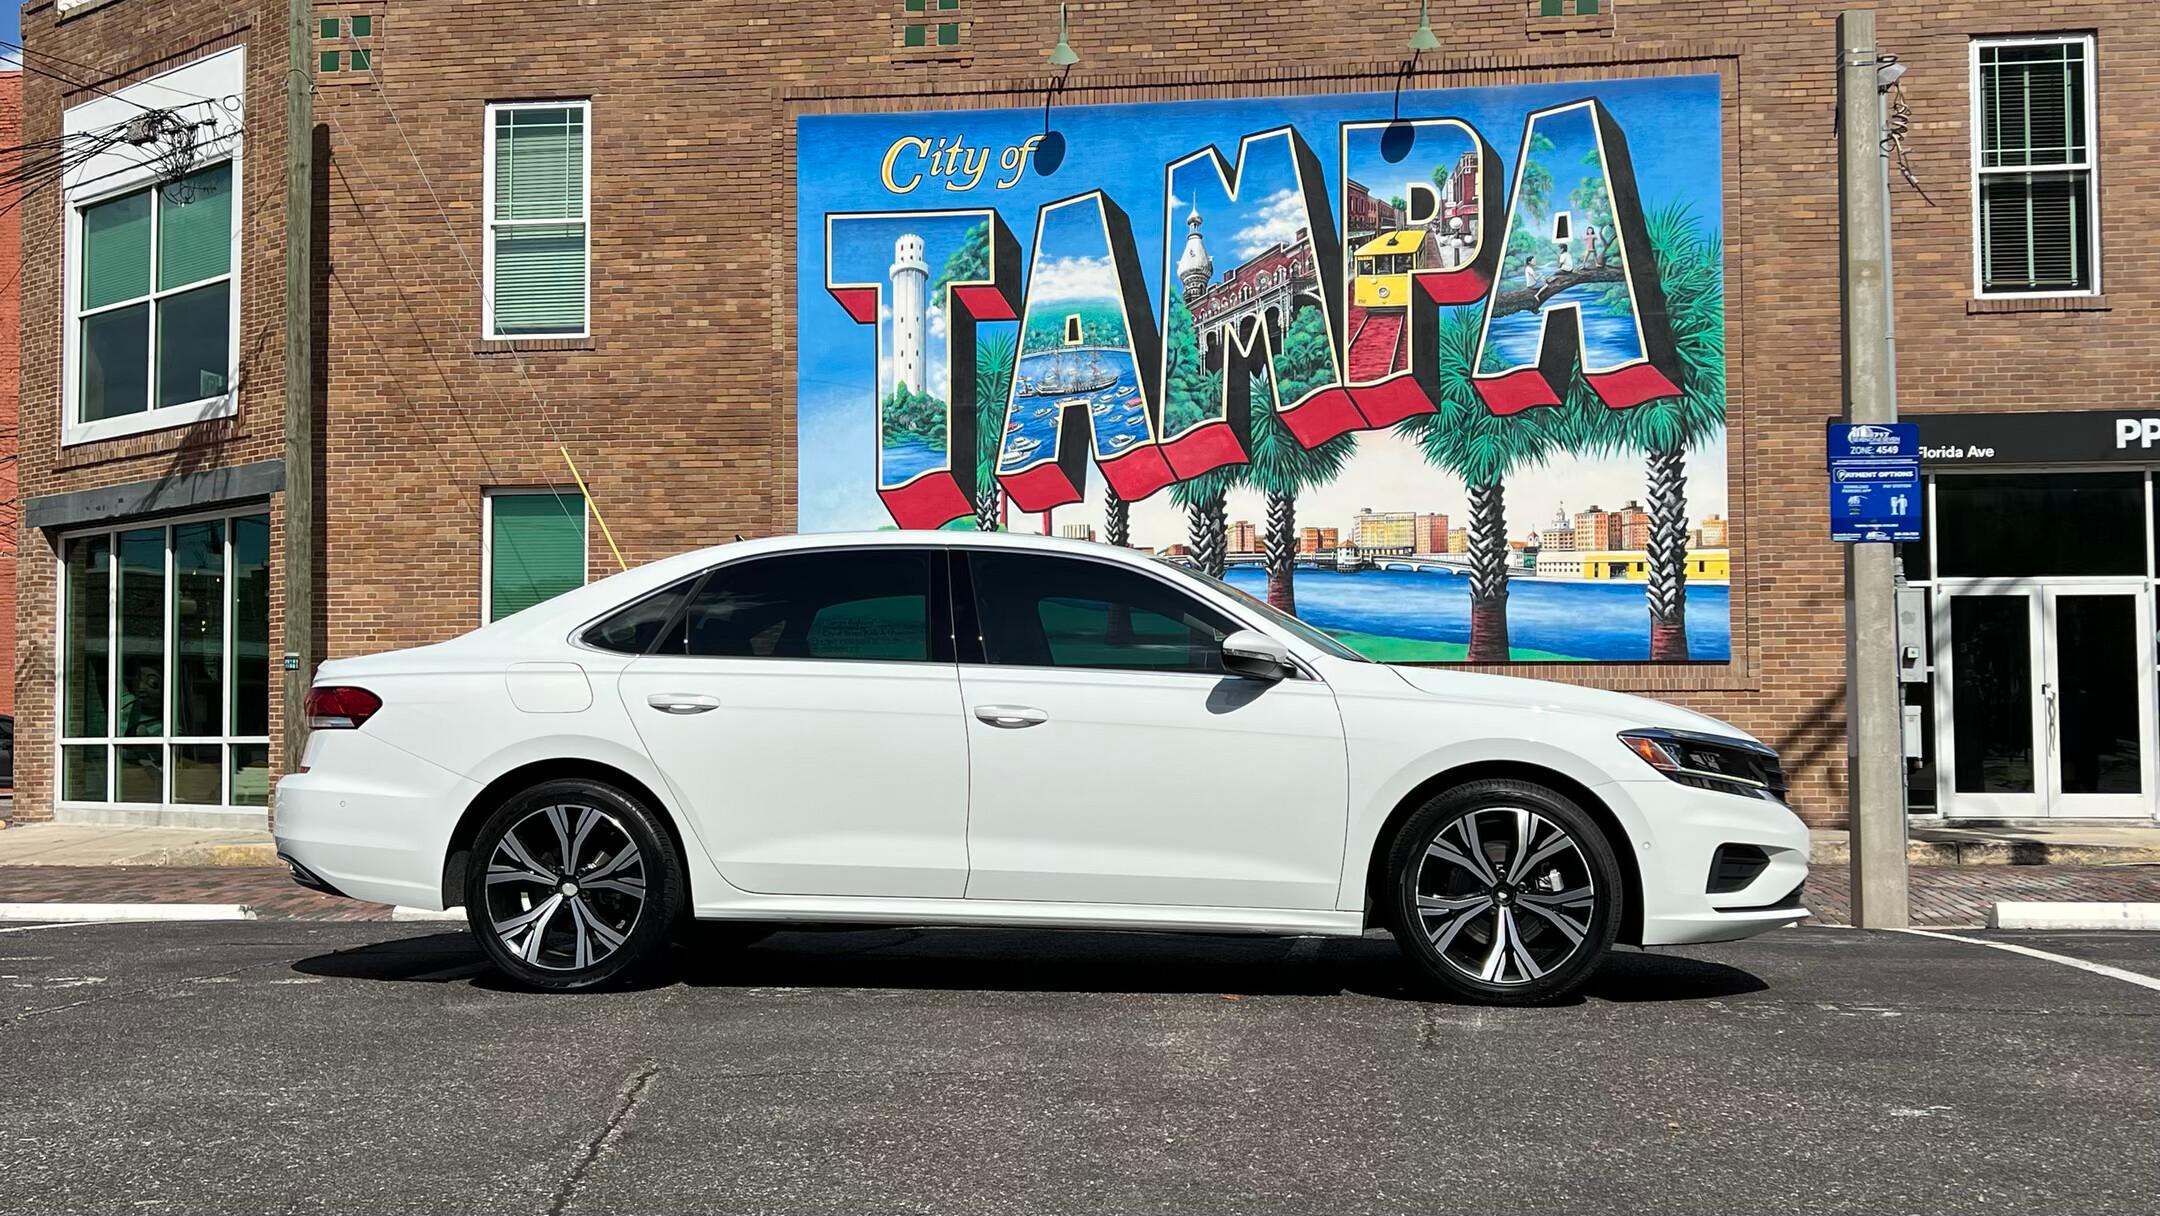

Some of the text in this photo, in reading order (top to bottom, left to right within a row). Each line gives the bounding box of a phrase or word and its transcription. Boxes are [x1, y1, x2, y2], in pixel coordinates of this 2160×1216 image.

[880, 134, 1048, 194] City of
[824, 97, 1684, 528] TAMPA
[2116, 418, 2160, 449] PP
[1876, 445, 1899, 454] 4549
[1967, 445, 1995, 458] Ave
